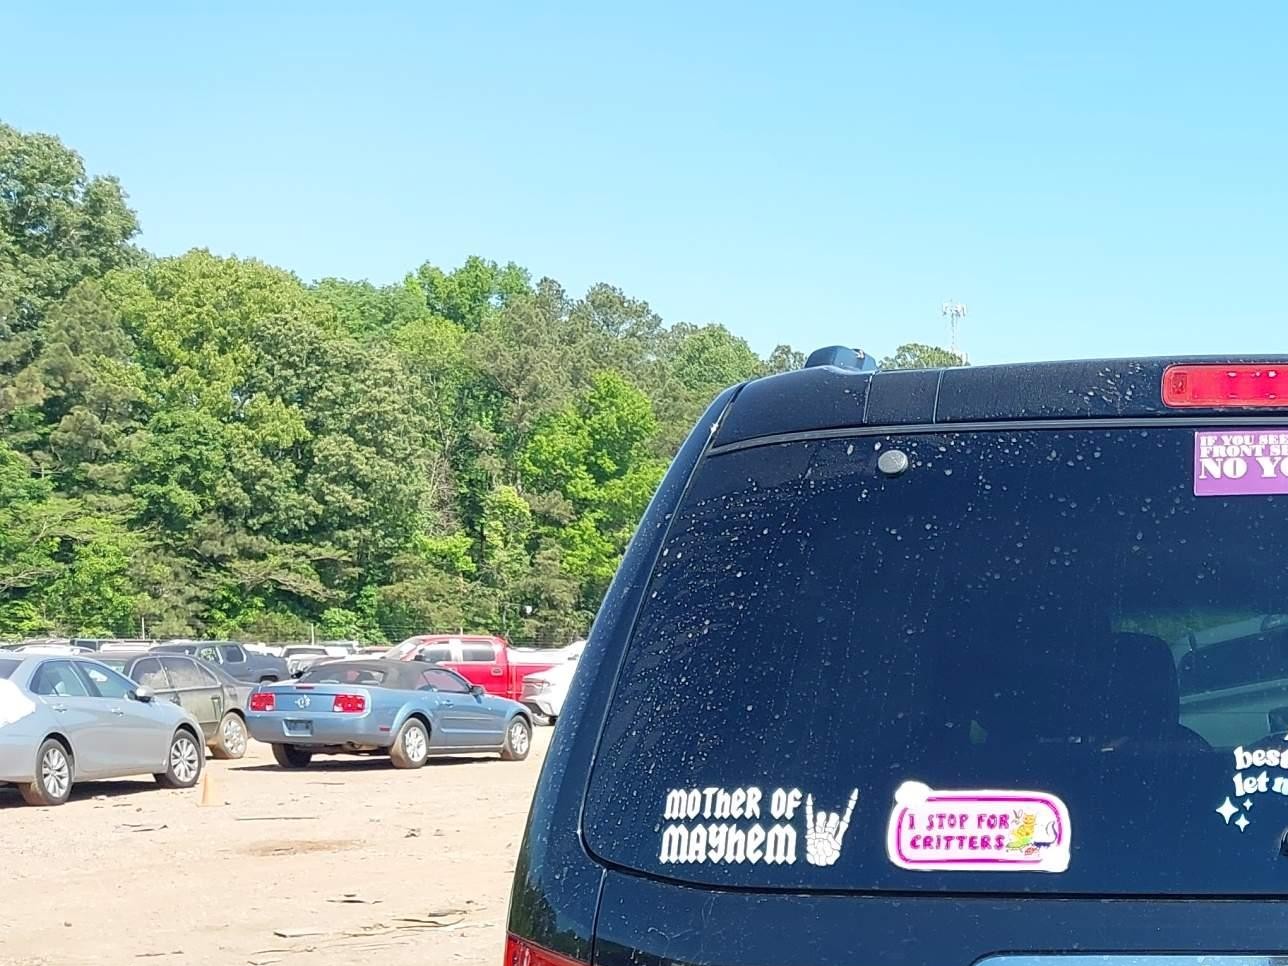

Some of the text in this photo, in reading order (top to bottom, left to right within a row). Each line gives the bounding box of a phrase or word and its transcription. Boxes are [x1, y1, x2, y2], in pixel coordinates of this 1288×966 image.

[1200, 435, 1217, 446] IF
[1221, 434, 1255, 445] YOU
[1200, 444, 1265, 458] FRONT
[1199, 457, 1248, 479] NO
[1233, 771, 1270, 797] let
[770, 787, 803, 820] OF
[907, 813, 1011, 832] I STOP FOR
[909, 835, 1005, 850] CRITTERS
